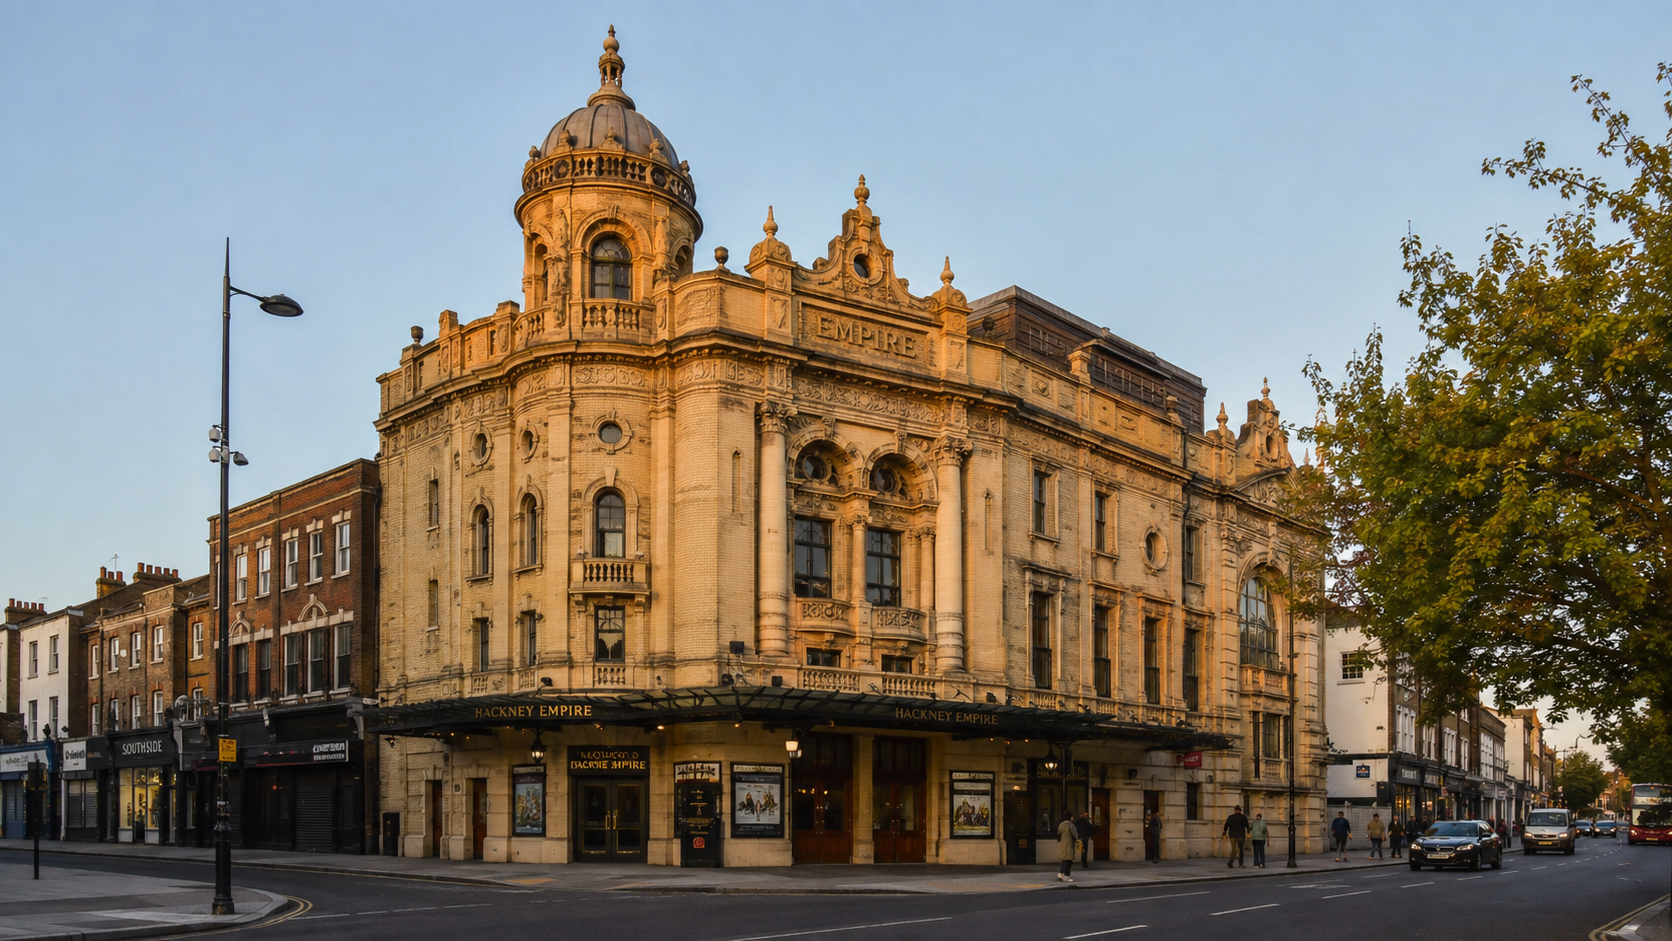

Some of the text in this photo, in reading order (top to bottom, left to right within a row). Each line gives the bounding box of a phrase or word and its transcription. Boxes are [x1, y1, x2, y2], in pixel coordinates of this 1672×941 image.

[817, 315, 917, 358] EMPIRE
[475, 704, 592, 718] HACKNEY EMPIRE
[895, 707, 998, 725] HACKNEY EMPIRE
